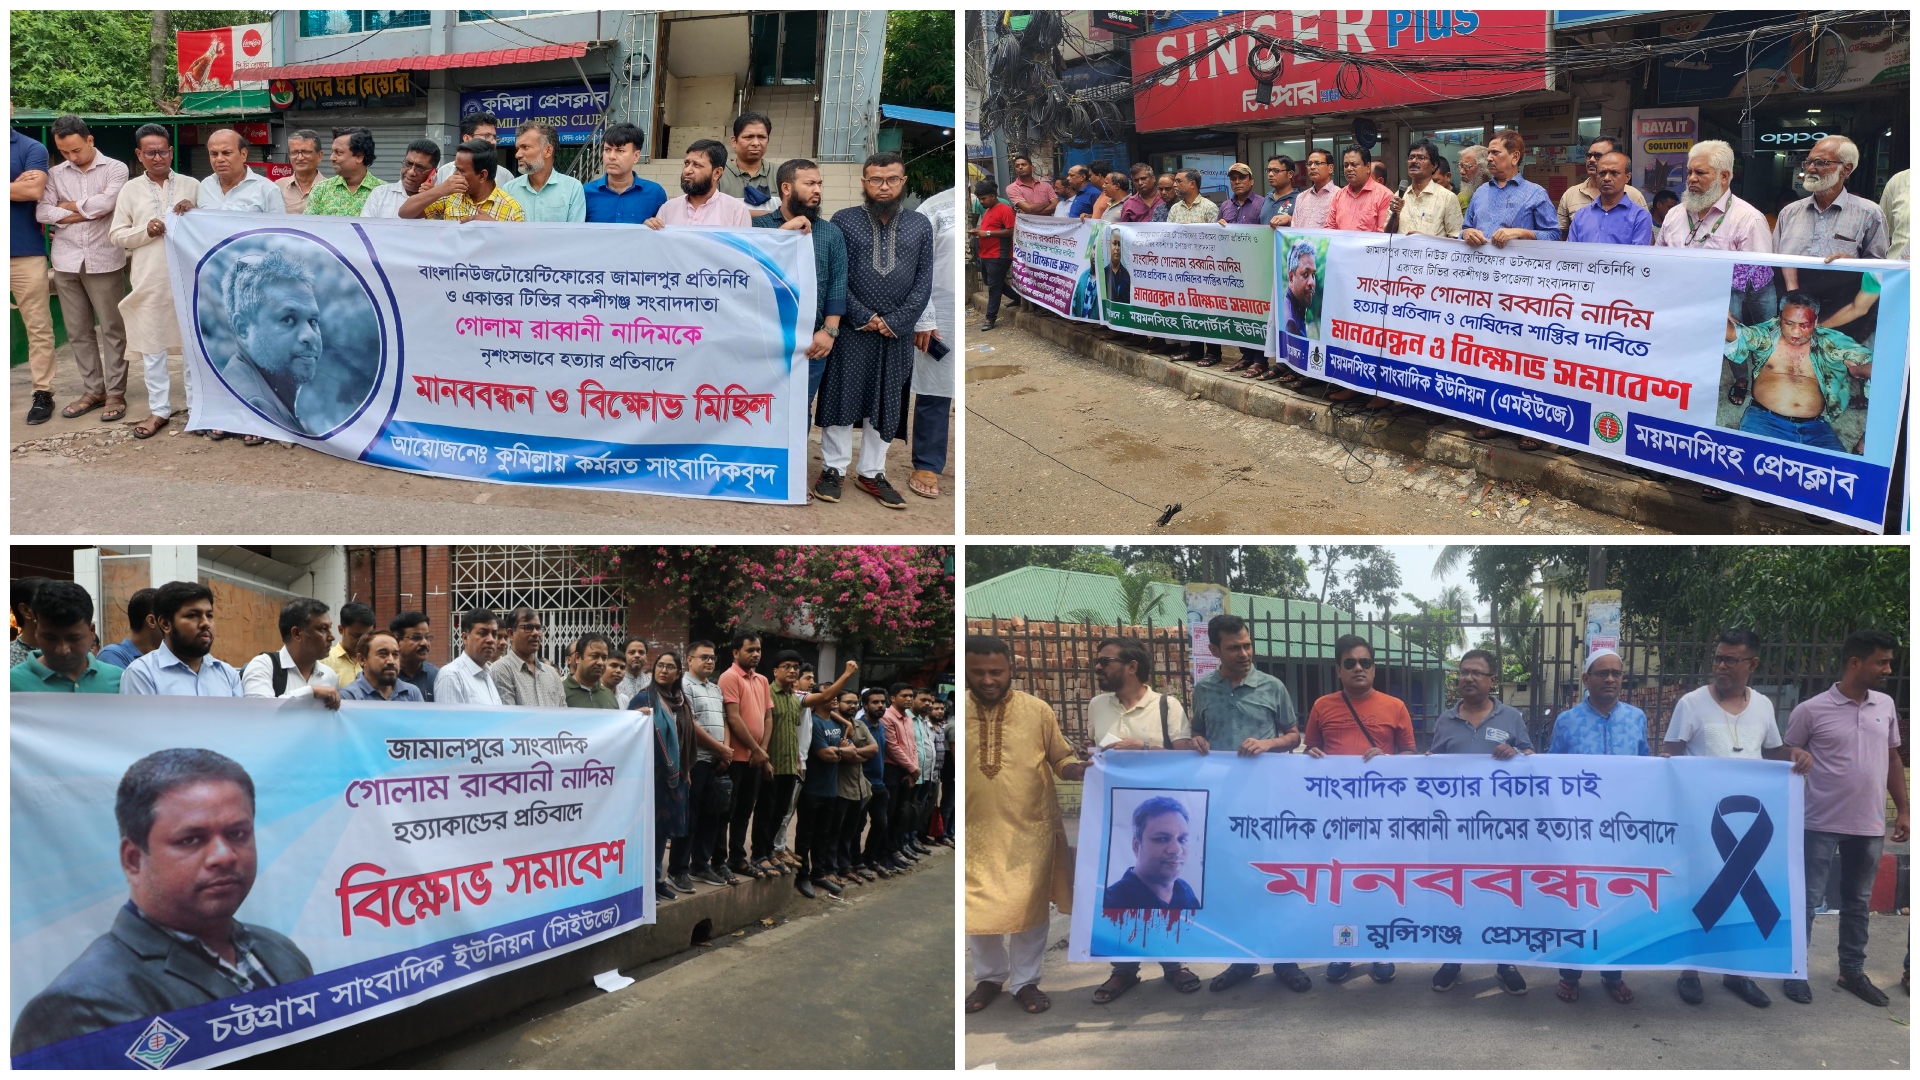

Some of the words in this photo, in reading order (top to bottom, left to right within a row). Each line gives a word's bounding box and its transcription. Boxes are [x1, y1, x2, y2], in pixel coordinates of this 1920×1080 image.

[481, 93, 534, 116] কুমিল্লা
[1641, 121, 1674, 133] RAYA
[1675, 120, 1688, 133] IT
[1648, 141, 1689, 150] SOLUTION
[609, 269, 680, 290] জামালপুর
[684, 268, 751, 290] প্রতিনিধি
[1132, 251, 1159, 267] সাংবাদিক
[1160, 256, 1187, 269] গোলাম
[1216, 257, 1241, 273] নাদিম
[1364, 245, 1400, 261] জামালপুর
[1401, 246, 1424, 261] বাংলা
[1425, 247, 1449, 263] নিউজ
[1509, 255, 1552, 272] ডটকমের
[1556, 260, 1584, 274] জেলা
[1585, 259, 1637, 279] প্রতিনিধি
[1641, 265, 1652, 278] ও
[1395, 262, 1424, 277] একাত্তর
[1425, 262, 1450, 279] টিভির
[1493, 268, 1534, 287] উপজেলা
[1536, 277, 1595, 294] সংবাদদাতা
[446, 291, 457, 304] ও
[461, 291, 513, 307] একাত্তর
[518, 288, 561, 309] টিভির
[567, 289, 633, 312] বকশীগঞ্জ
[635, 295, 721, 314] সংবাদদাতা
[1133, 286, 1175, 307] মানববন্ধন
[1178, 292, 1186, 306] ও
[1187, 287, 1228, 311] বিক্ষোভ
[1356, 275, 1425, 300] সাংবাদিক
[1430, 283, 1491, 310] গোলাম
[1498, 291, 1573, 321] রব্বানি
[1580, 298, 1655, 332] নাদিম
[455, 315, 524, 340] গোলাম
[528, 314, 604, 344] রাব্বানী
[609, 316, 705, 347] নাদিমকে
[1129, 310, 1180, 331] ময়মনসিংহ
[1180, 314, 1232, 335] রিপোর্টার্স
[1353, 299, 1388, 316] হত্যার
[1391, 300, 1442, 325] প্রতিবাদ
[1444, 312, 1455, 327] ও
[1459, 312, 1522, 338] দোষিদের
[1527, 320, 1580, 347] শাস্তির
[1584, 327, 1652, 357] দাবিতে
[480, 346, 555, 370] নৃশংসভাবে
[558, 350, 604, 369] হত্যার
[609, 351, 677, 374] প্রতিবাদে
[1331, 318, 1425, 357] মানববন্ধন
[1428, 335, 1446, 359] ও
[1450, 332, 1549, 381] বিক্ষোভ
[1552, 358, 1694, 411] সমাবেশ
[411, 374, 540, 415] মানববন্ধন
[546, 387, 570, 413] ও
[577, 378, 687, 422] বিক্ষোভ
[693, 383, 777, 426] মিছিল
[1329, 351, 1378, 382] ময়মনসিংহ
[1379, 363, 1433, 392] সাংবাদিক
[1434, 374, 1487, 406] ইউনিয়ন
[1490, 387, 1576, 432] (এমইউজে)
[494, 441, 570, 475] কুমিল্লায়
[573, 450, 641, 476] কর্মরত
[645, 452, 780, 494] সাংবাদিকবৃন্দ
[1633, 423, 1746, 476] ময়মনসিংহ
[1753, 452, 1860, 500] প্রেসক্লাব
[385, 736, 505, 765] জামালপুরে
[510, 730, 589, 758] সাংবাদিক
[344, 774, 451, 809] গোলাম
[457, 760, 555, 799] রাব্বানী
[560, 758, 616, 789] নাদিম
[1304, 770, 1408, 801] সাংবাদিক
[1415, 774, 1483, 799] হত্যার
[1489, 767, 1553, 799] বিচার
[1558, 770, 1603, 800] চাই
[513, 799, 584, 828] প্রতিবাদে
[1228, 809, 1318, 842] সাংবাদিক
[1321, 816, 1382, 842] গোলাম
[1387, 809, 1452, 842] রাব্বানী
[1455, 810, 1531, 842] নাদিমের
[1534, 817, 1594, 843] হত্যার
[1598, 810, 1680, 846] প্রতিবাদে
[334, 861, 494, 937] বিক্ষোভ
[502, 838, 626, 895] সমাবেশ
[1248, 858, 1676, 914] মানববন্ধন
[1366, 917, 1463, 952] মুন্সিগঞ্জ
[205, 990, 321, 1044] চট্টগ্রাম
[330, 952, 447, 1009] সাংবাদিক
[450, 928, 536, 972] ইউনিয়ন
[542, 902, 621, 951] (সিইউজে)
